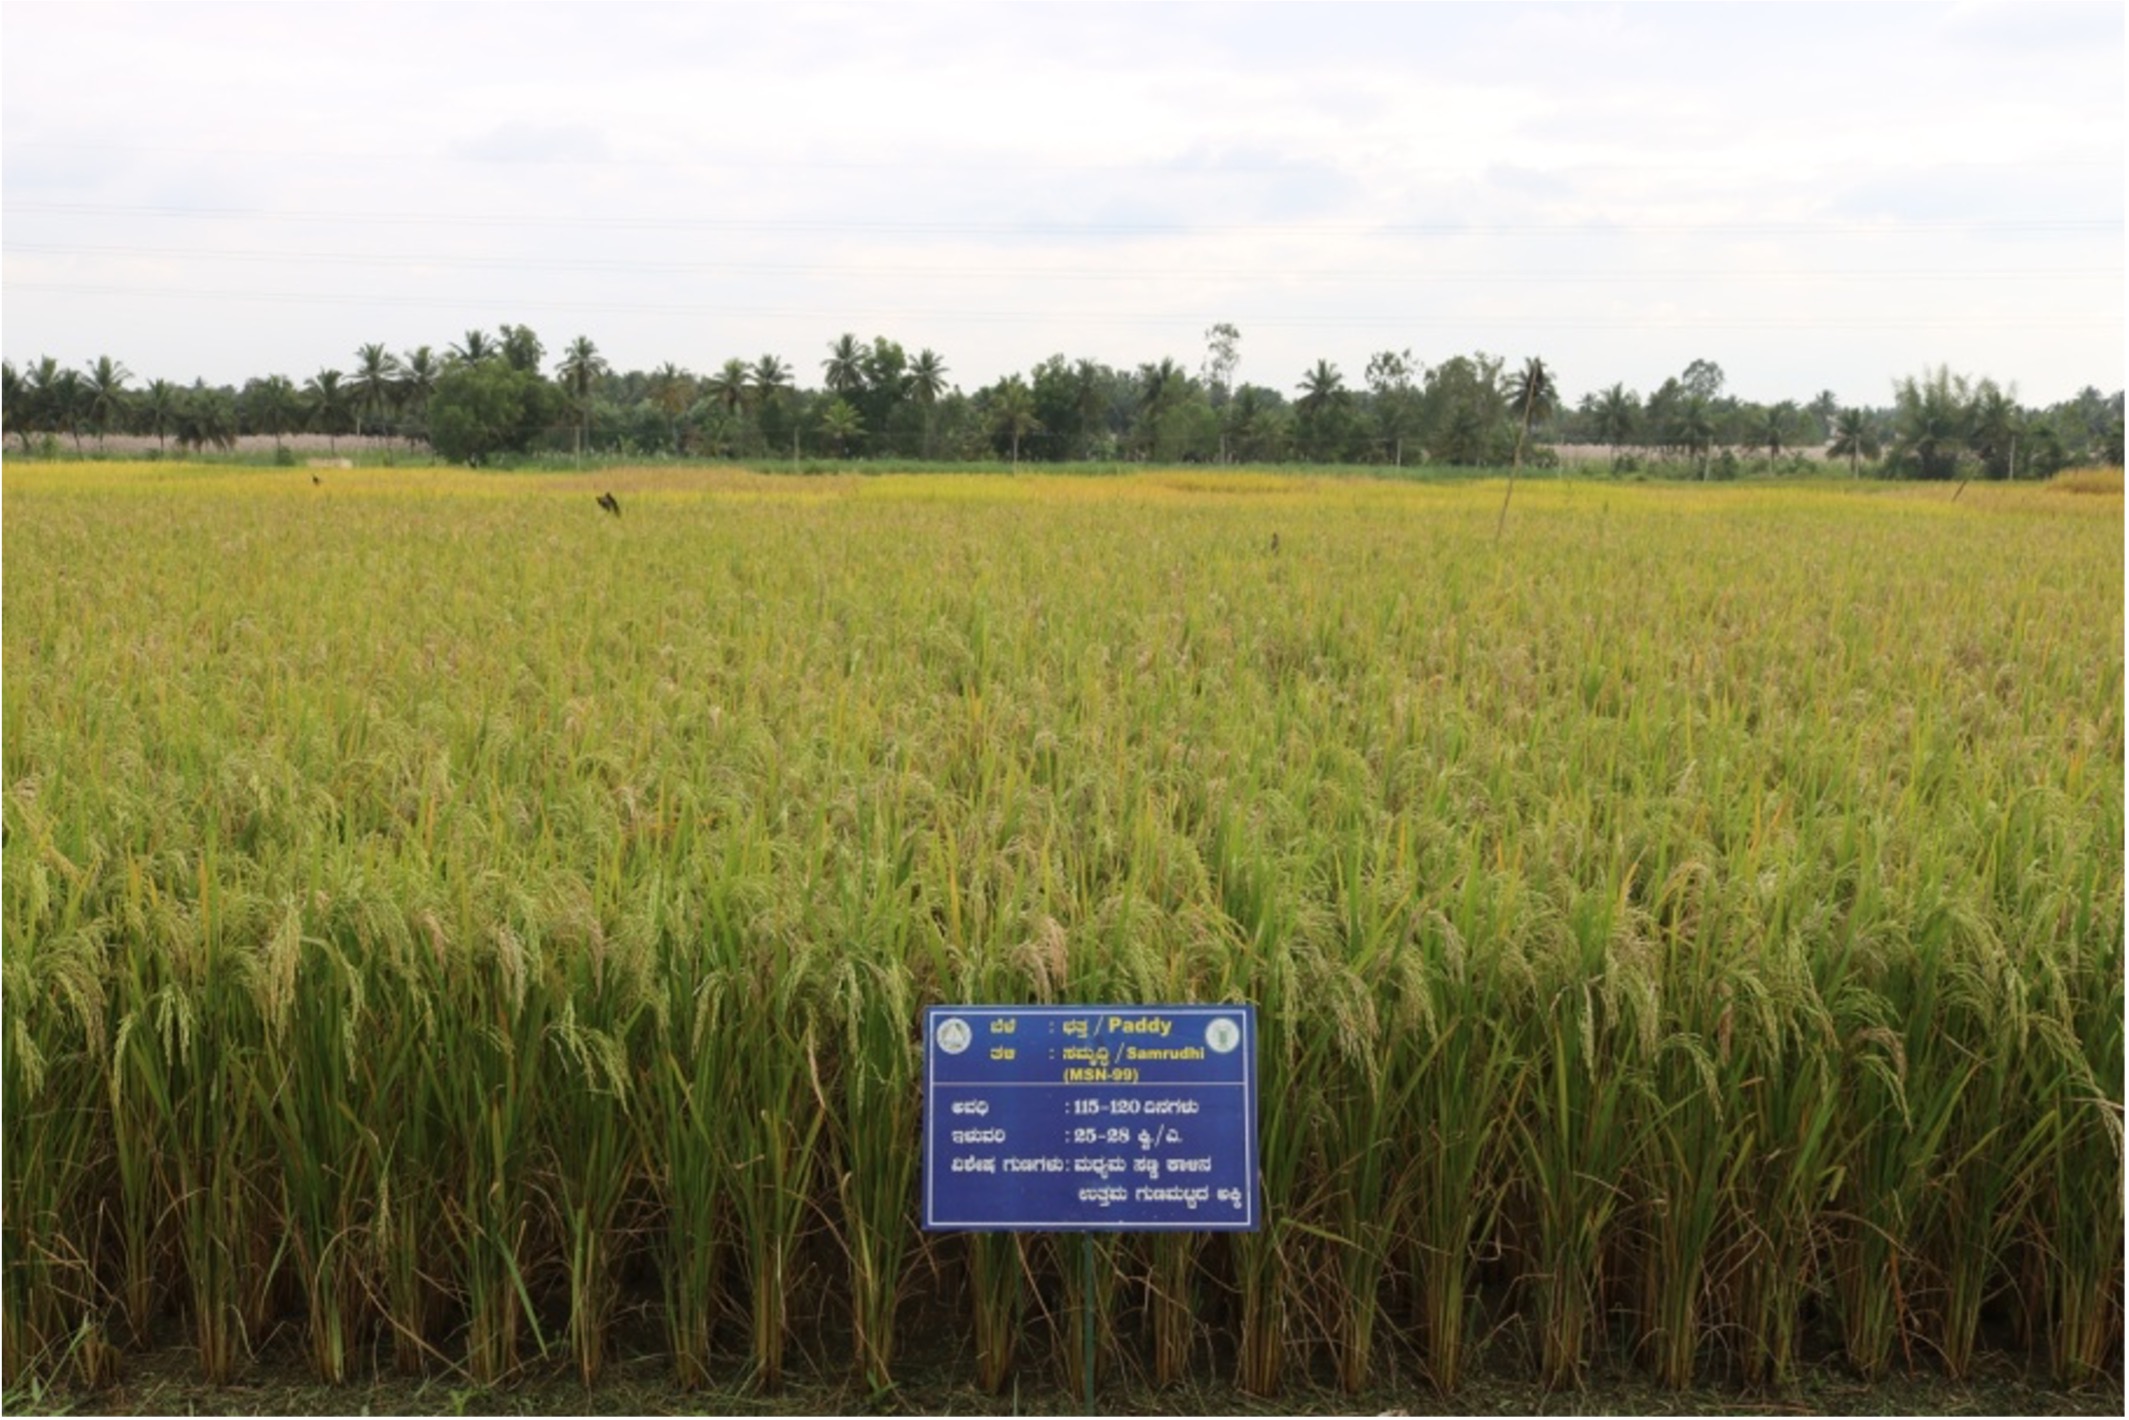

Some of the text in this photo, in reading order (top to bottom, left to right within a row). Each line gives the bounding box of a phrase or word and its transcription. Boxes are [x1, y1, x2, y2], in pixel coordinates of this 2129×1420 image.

[1108, 1017, 1172, 1036] Paddy
[1063, 1068, 1139, 1084] (MSN-99)
[1073, 1127, 1130, 1143] 25-28
